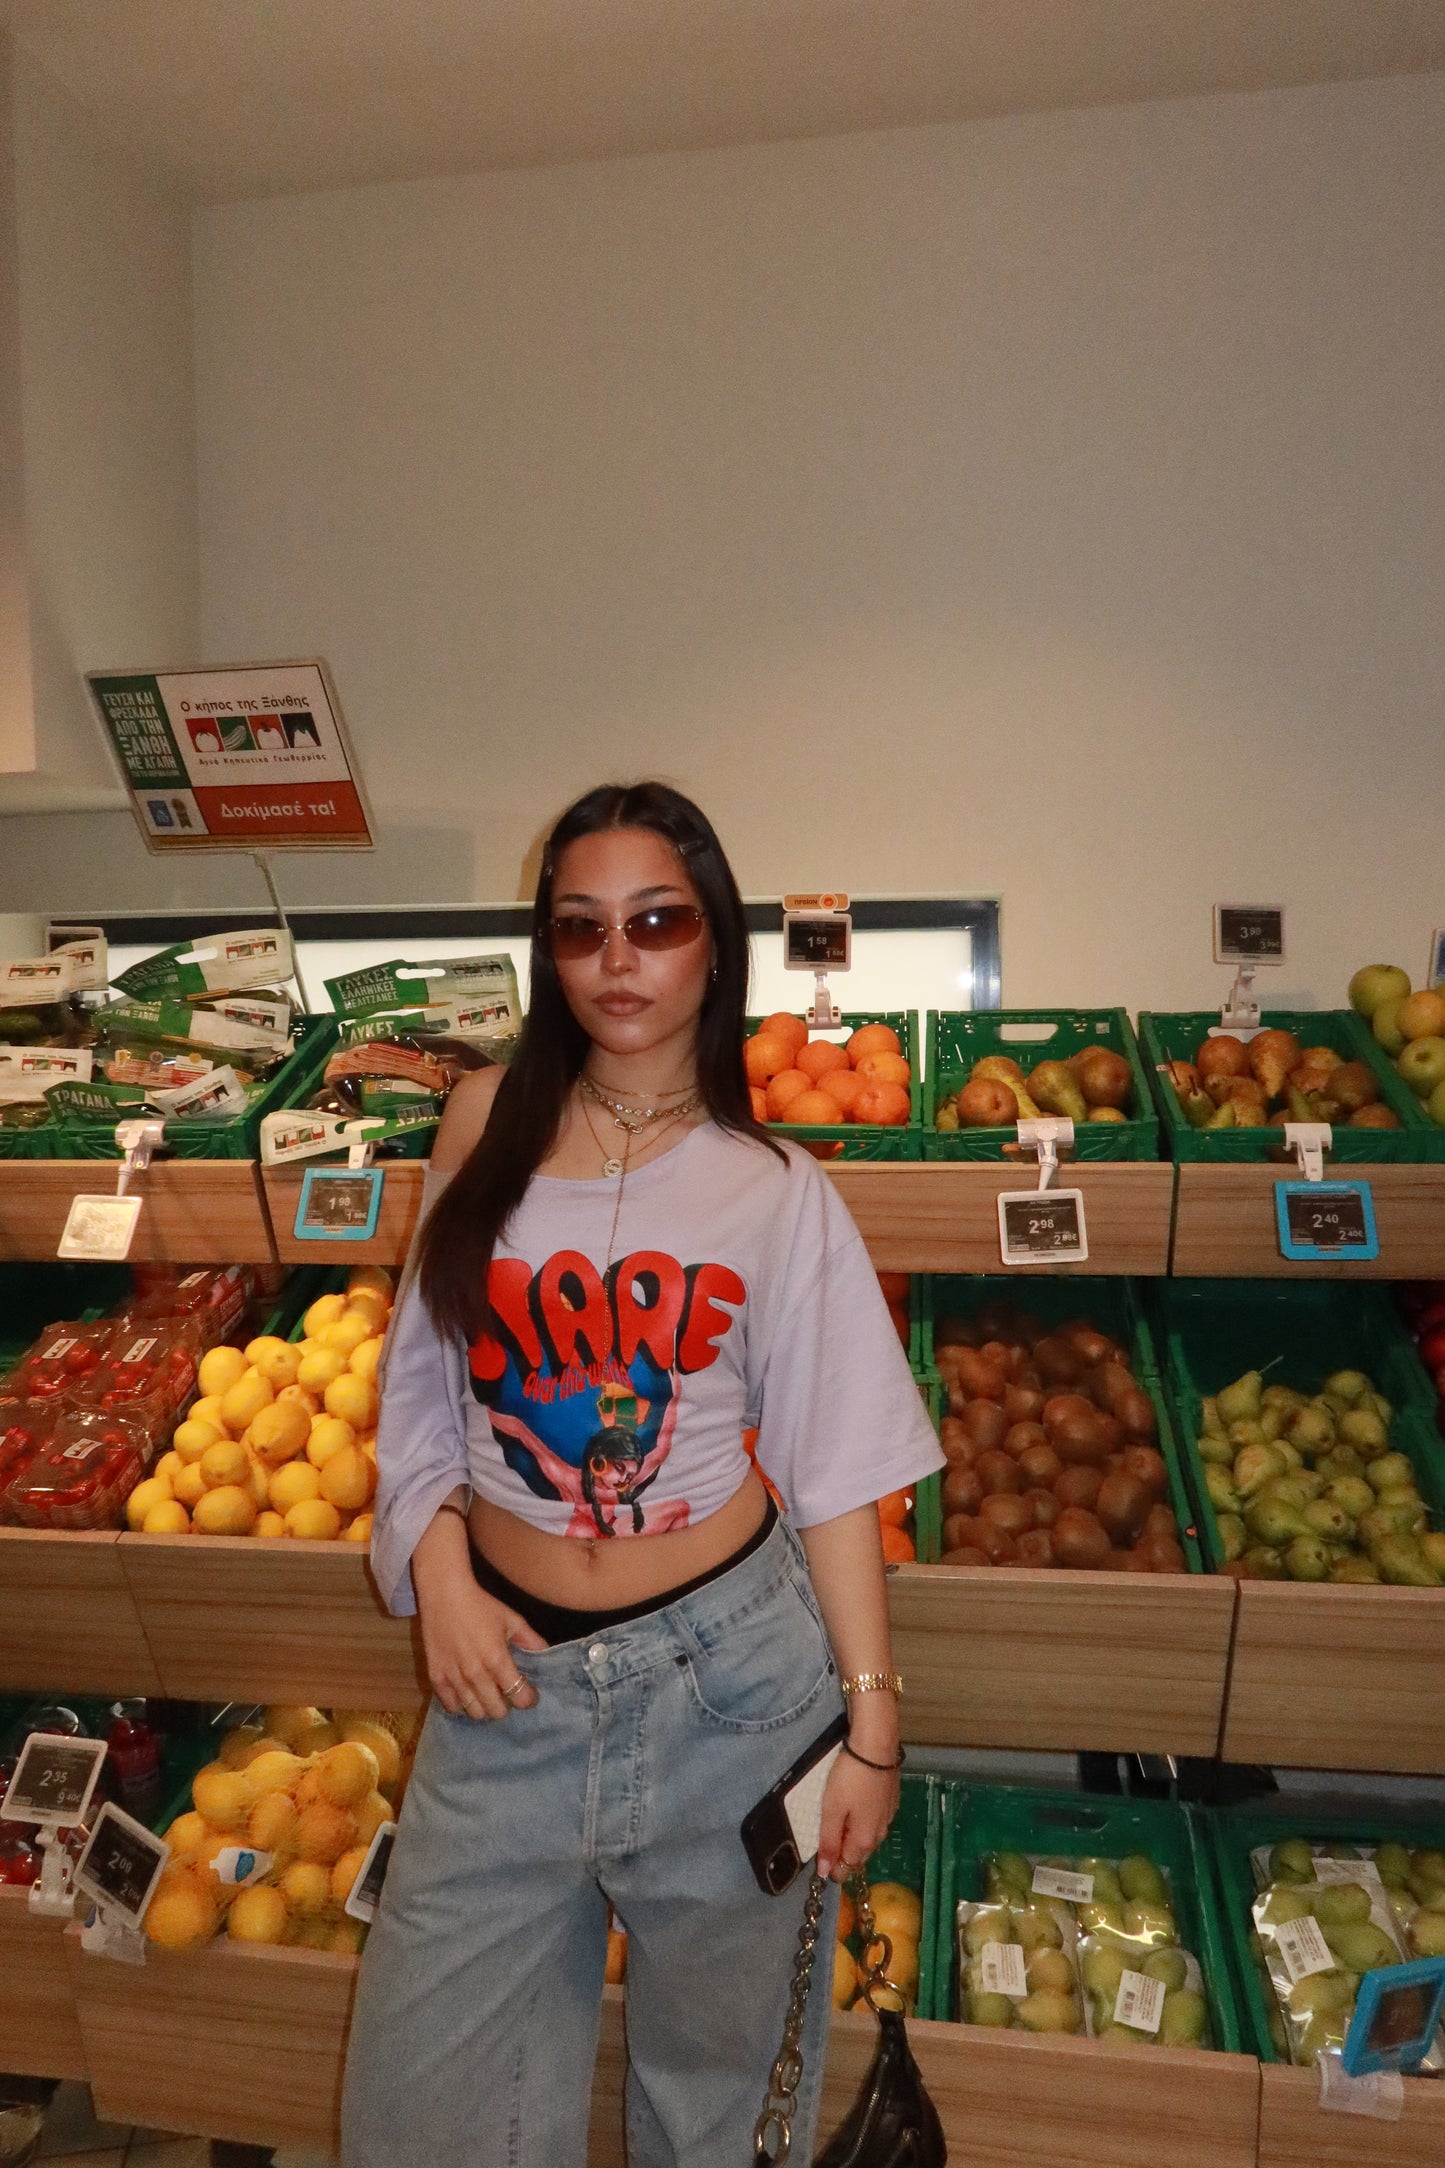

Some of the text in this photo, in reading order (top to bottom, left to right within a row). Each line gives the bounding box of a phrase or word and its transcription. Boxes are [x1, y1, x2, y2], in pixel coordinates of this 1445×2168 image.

[135, 691, 155, 705] ΚΑΙ
[237, 699, 258, 711] της
[138, 719, 166, 735] ΤΗΝ
[119, 735, 173, 755] ΞΑΝΘΗ
[308, 800, 337, 816] τα!
